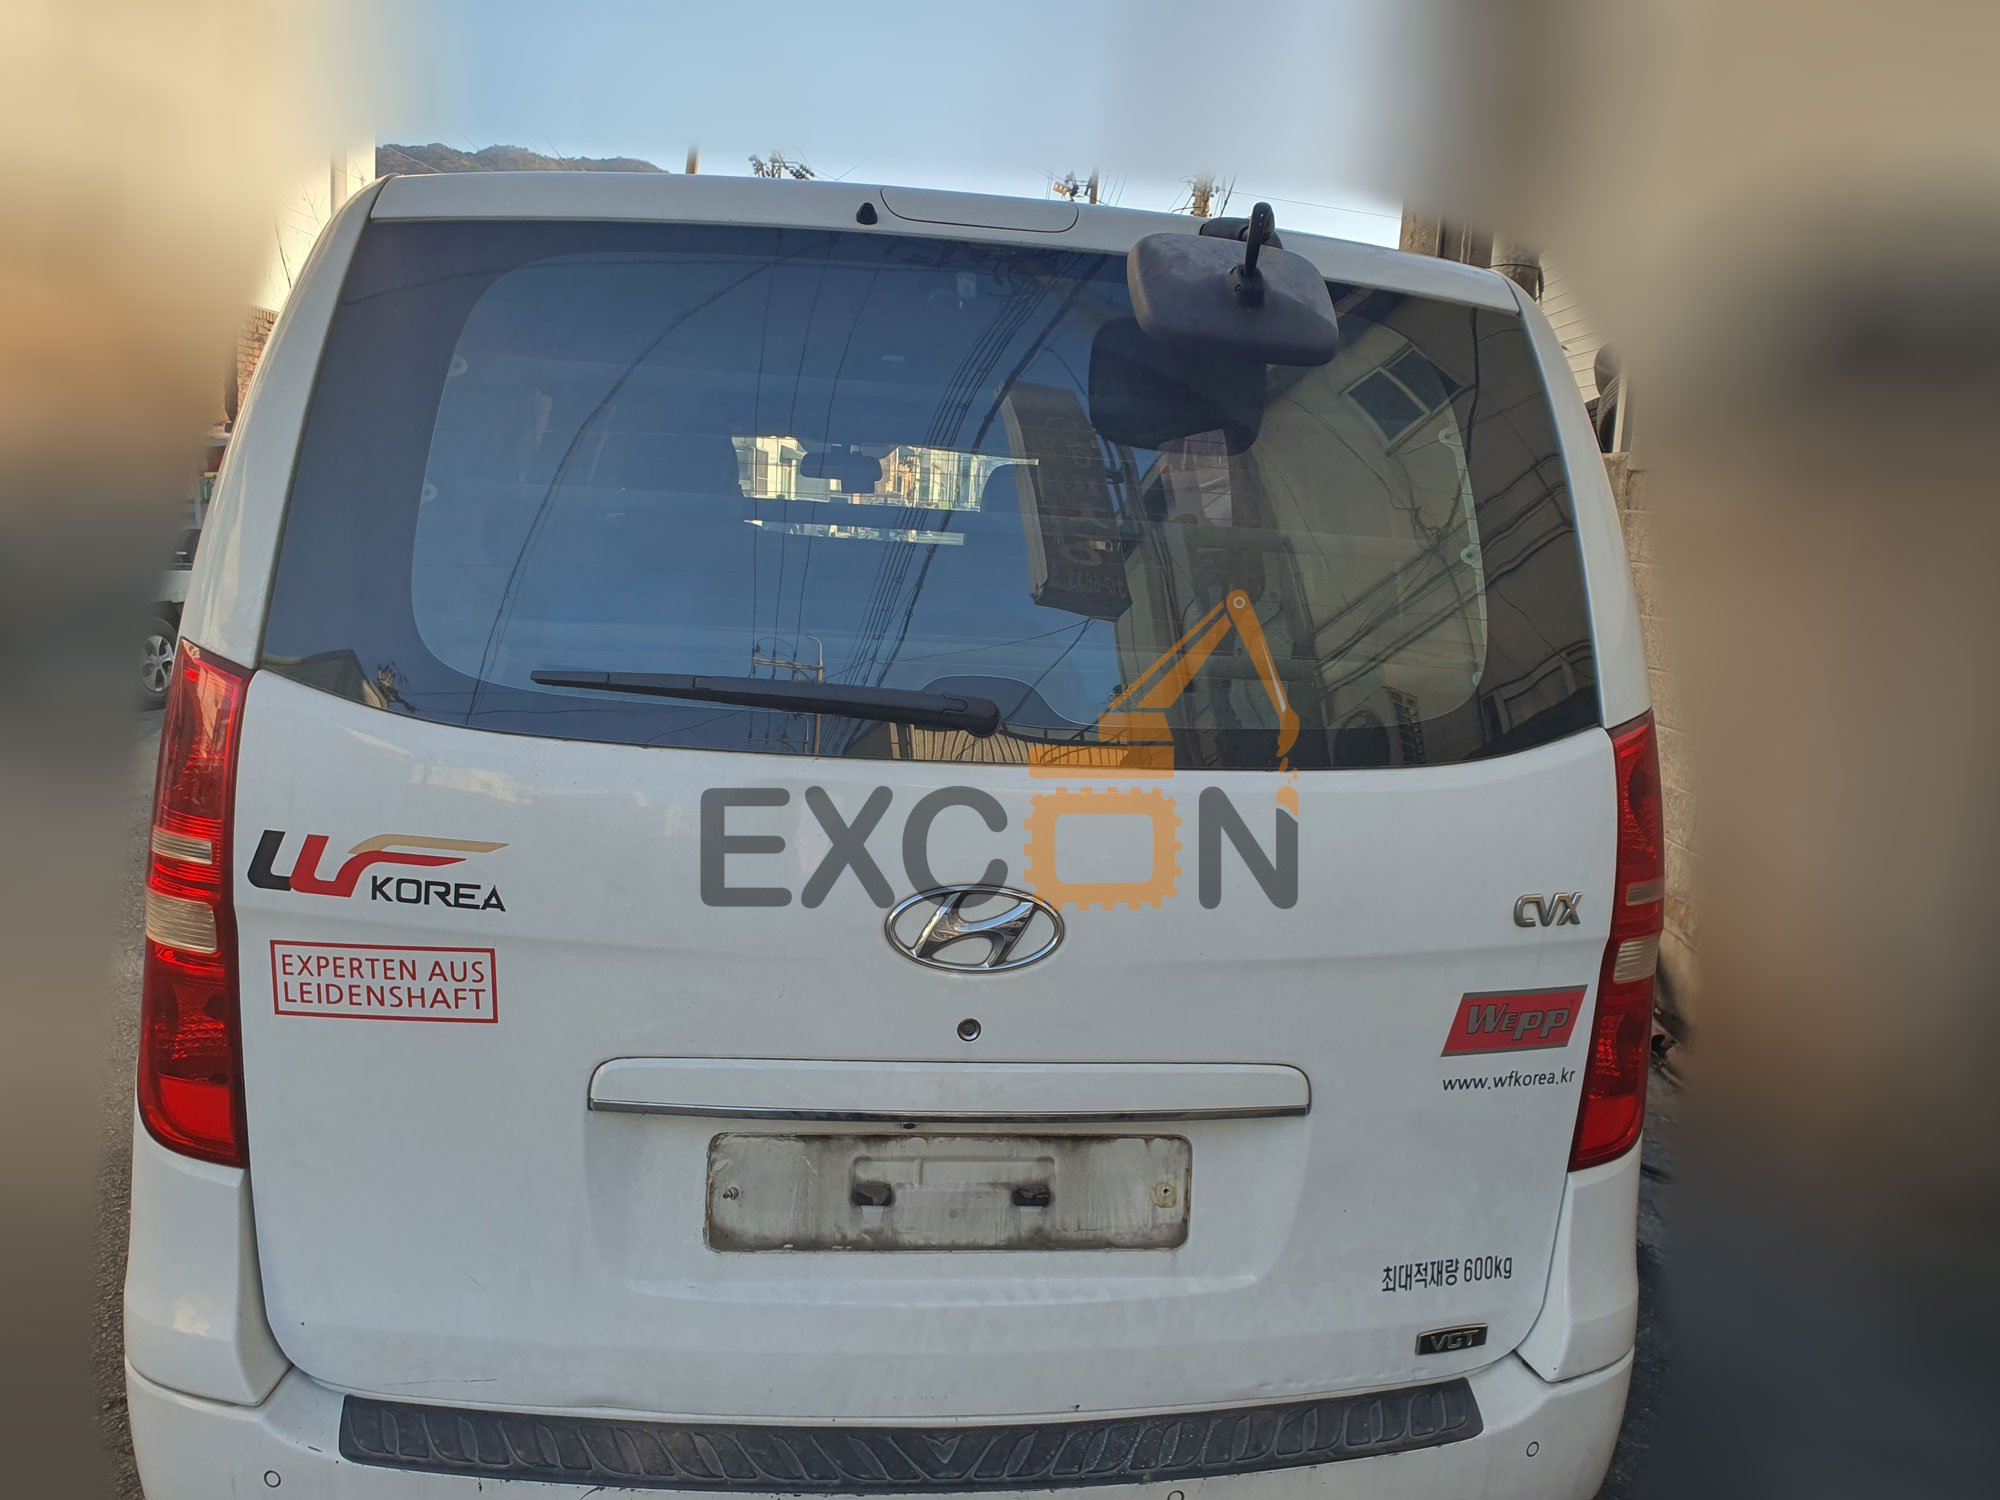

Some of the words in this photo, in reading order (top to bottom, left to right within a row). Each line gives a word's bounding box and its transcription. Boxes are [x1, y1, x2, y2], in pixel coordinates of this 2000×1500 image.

[371, 875, 506, 912] KOREA
[1513, 892, 1584, 927] CVX
[281, 954, 416, 981] EXPERTEN
[428, 960, 485, 983] AUS
[283, 982, 486, 1010] LEIDENSHAFT
[1442, 1068, 1576, 1091] www.wfkorea.kr
[1381, 1258, 1460, 1292] 최대적재량
[1463, 1256, 1513, 1282] 600kg
[1430, 1330, 1480, 1351] VGT
